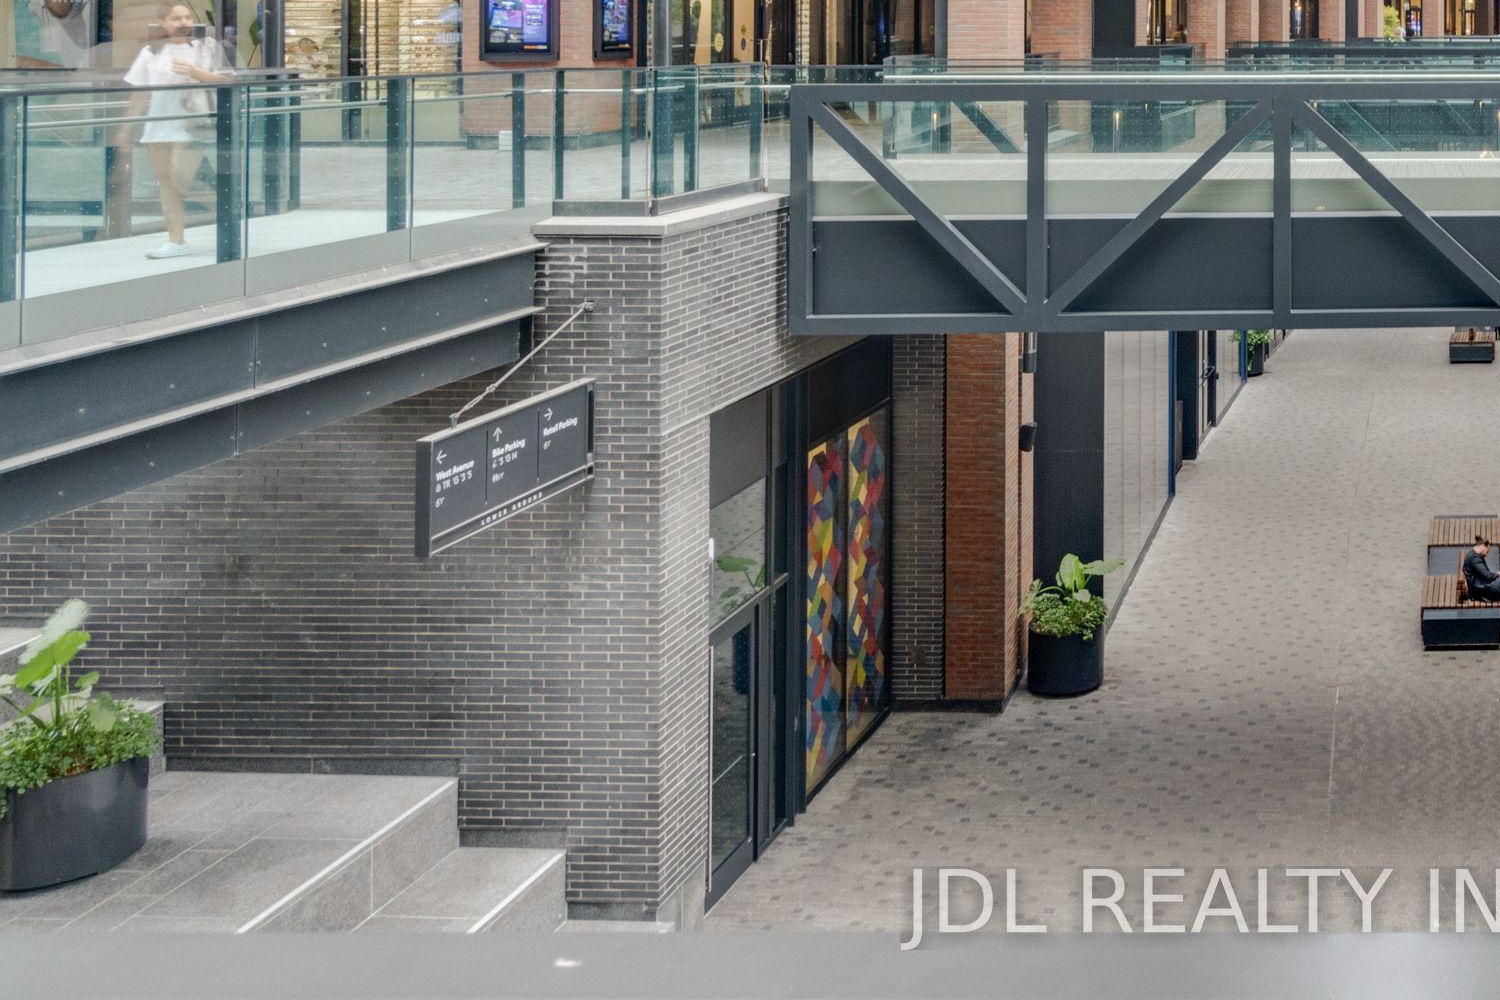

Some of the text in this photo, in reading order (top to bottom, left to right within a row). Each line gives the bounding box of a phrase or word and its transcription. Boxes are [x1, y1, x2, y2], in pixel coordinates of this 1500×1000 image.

[559, 417, 578, 430] Parking
[492, 439, 526, 458] Bike Parking
[435, 460, 474, 481] West Avenue
[481, 492, 543, 526] LOWER GROUND
